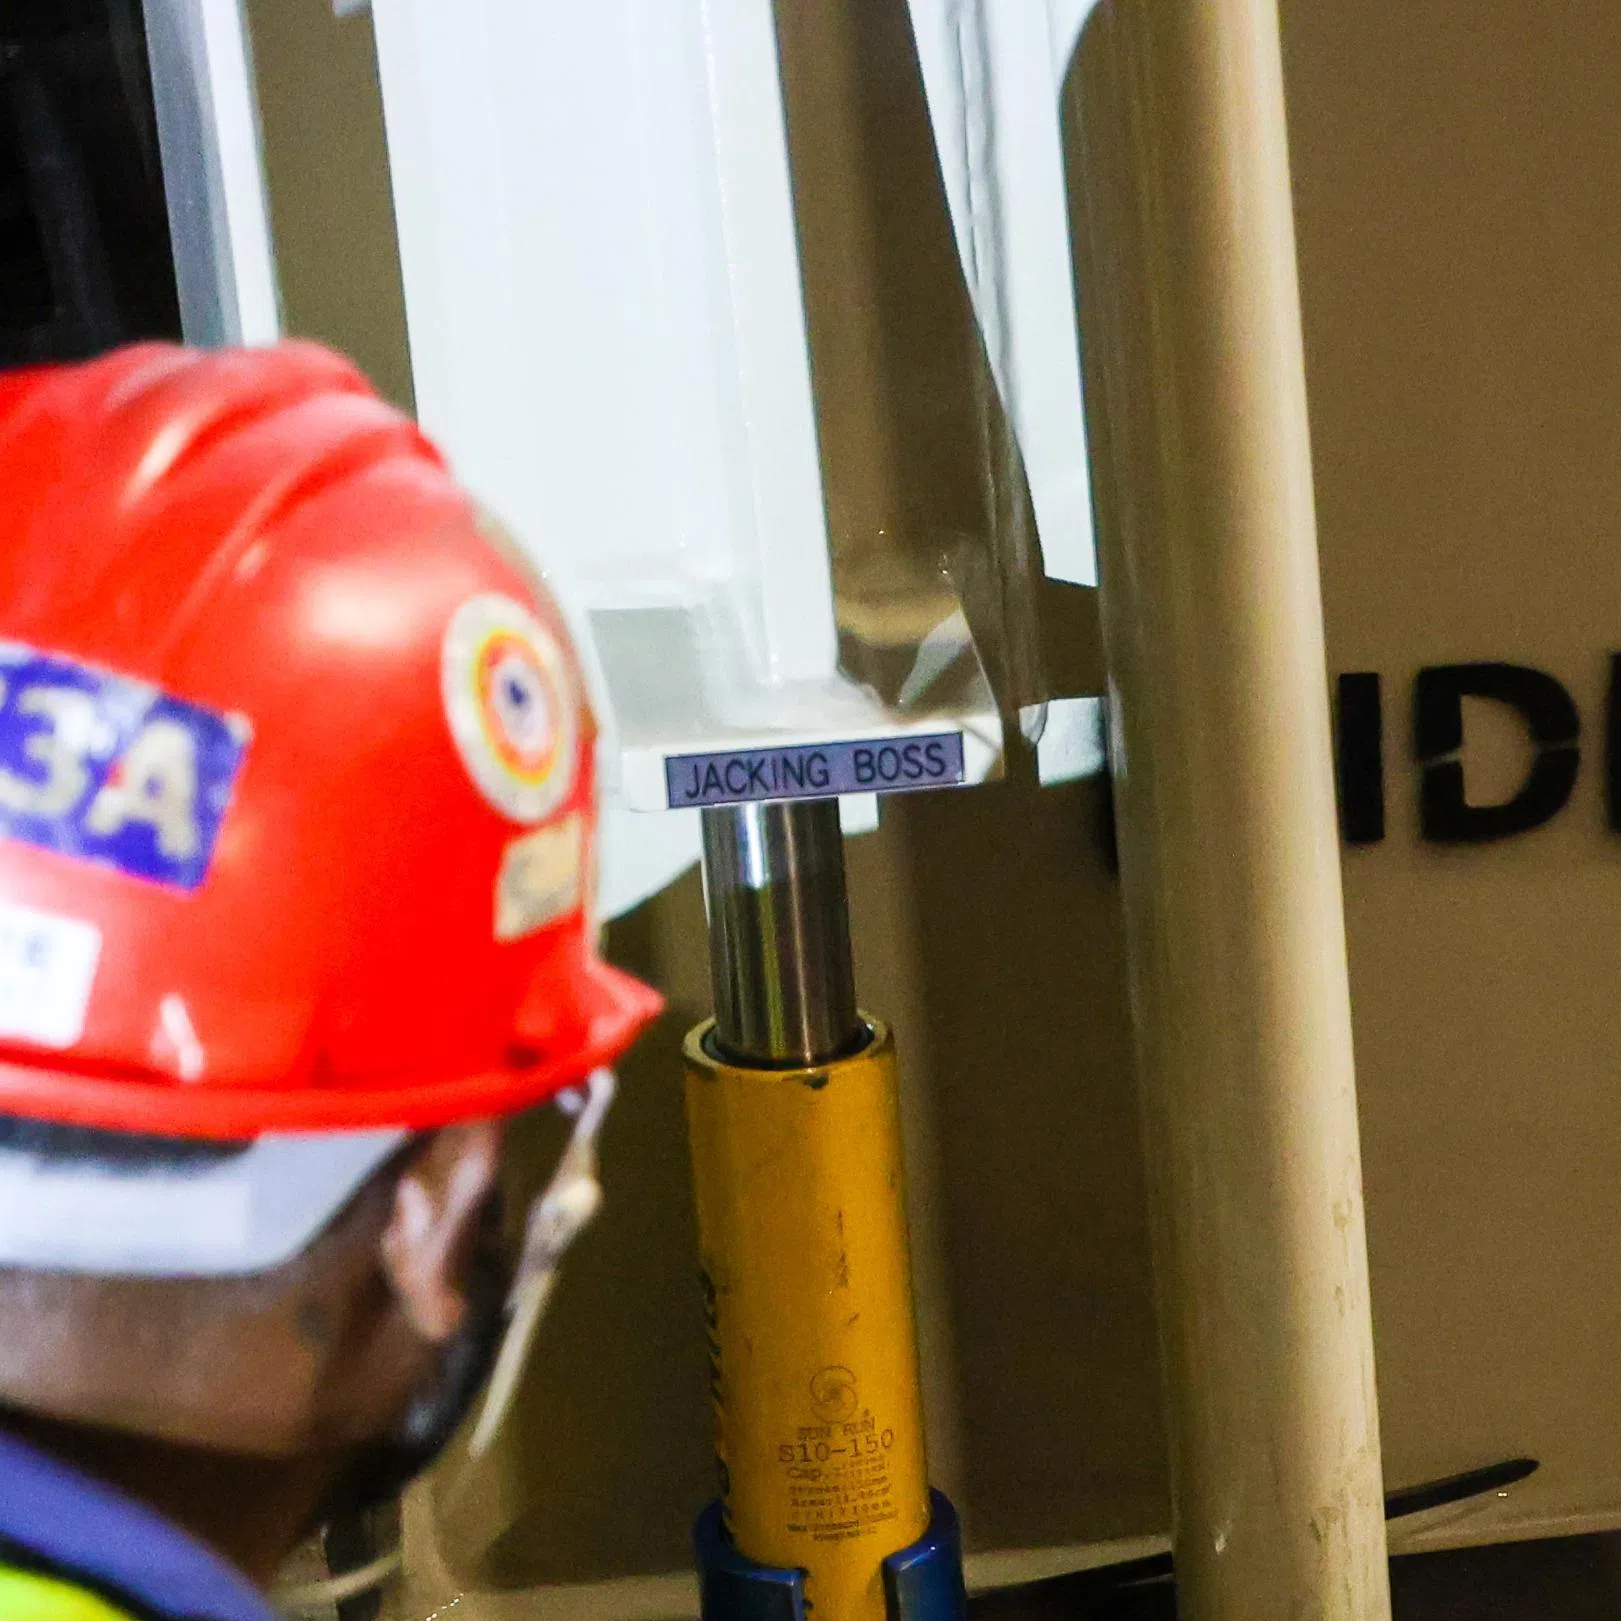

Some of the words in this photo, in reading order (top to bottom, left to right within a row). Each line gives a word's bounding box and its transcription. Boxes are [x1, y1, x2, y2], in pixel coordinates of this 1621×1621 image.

[0, 686, 200, 860] 3A
[685, 752, 830, 799] JACKING
[853, 742, 947, 784] BOSS
[777, 1427, 895, 1463] S10-150
